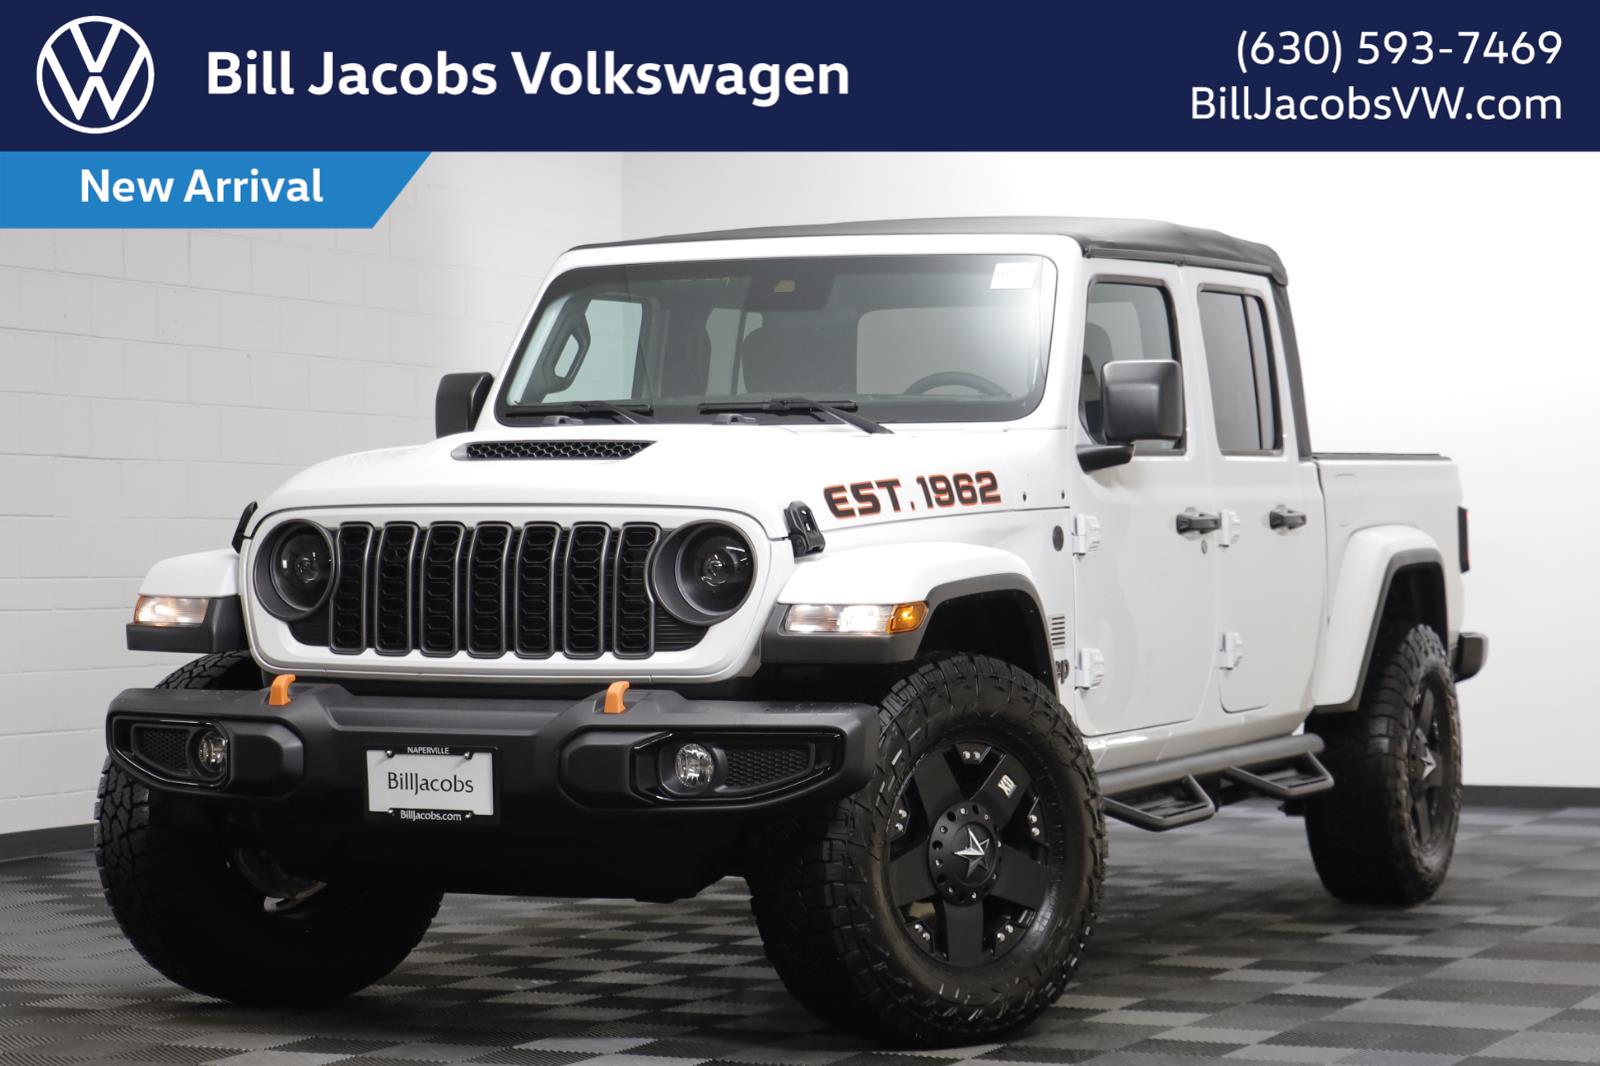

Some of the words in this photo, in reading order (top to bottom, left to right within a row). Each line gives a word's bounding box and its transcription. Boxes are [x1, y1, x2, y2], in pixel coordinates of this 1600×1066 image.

[823, 477, 916, 520] EST.
[916, 470, 1003, 510] 1962
[407, 746, 450, 755] NAPERVILLE
[387, 771, 474, 796] BillJacobs
[400, 809, 462, 822] BillJacobs.com
